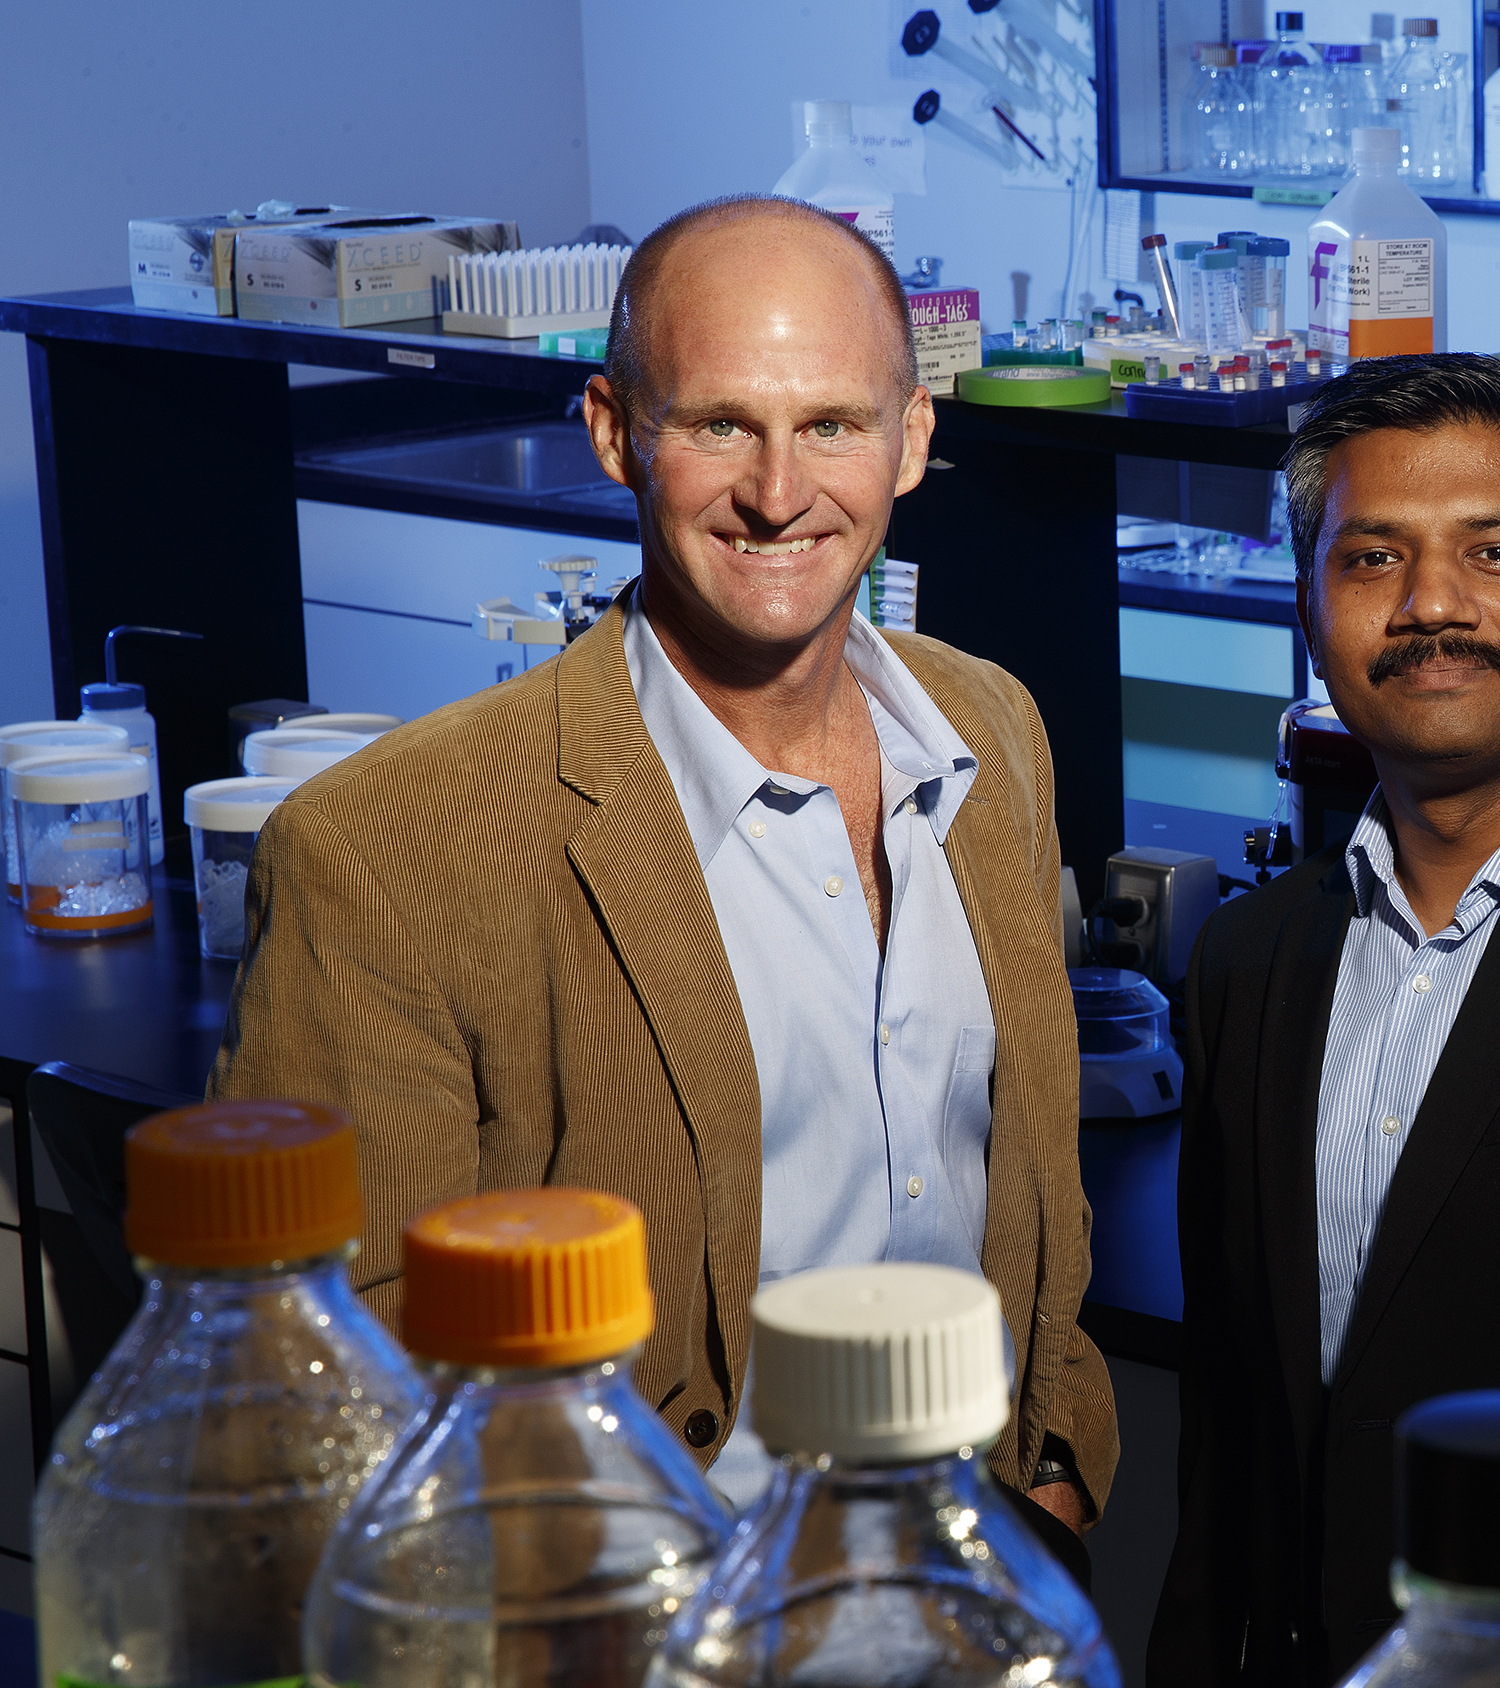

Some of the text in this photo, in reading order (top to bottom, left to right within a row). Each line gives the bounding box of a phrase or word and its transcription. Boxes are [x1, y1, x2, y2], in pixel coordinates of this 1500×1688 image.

[860, 134, 886, 149] your
[890, 135, 913, 148] own
[347, 243, 422, 269] XCEED
[1358, 255, 1362, 263] 1
[1364, 255, 1370, 263] L
[138, 263, 147, 275] M
[247, 274, 254, 287] S
[355, 279, 362, 292] S
[907, 294, 967, 309] ICROTUBE
[909, 304, 969, 326] OUGH-TAGS
